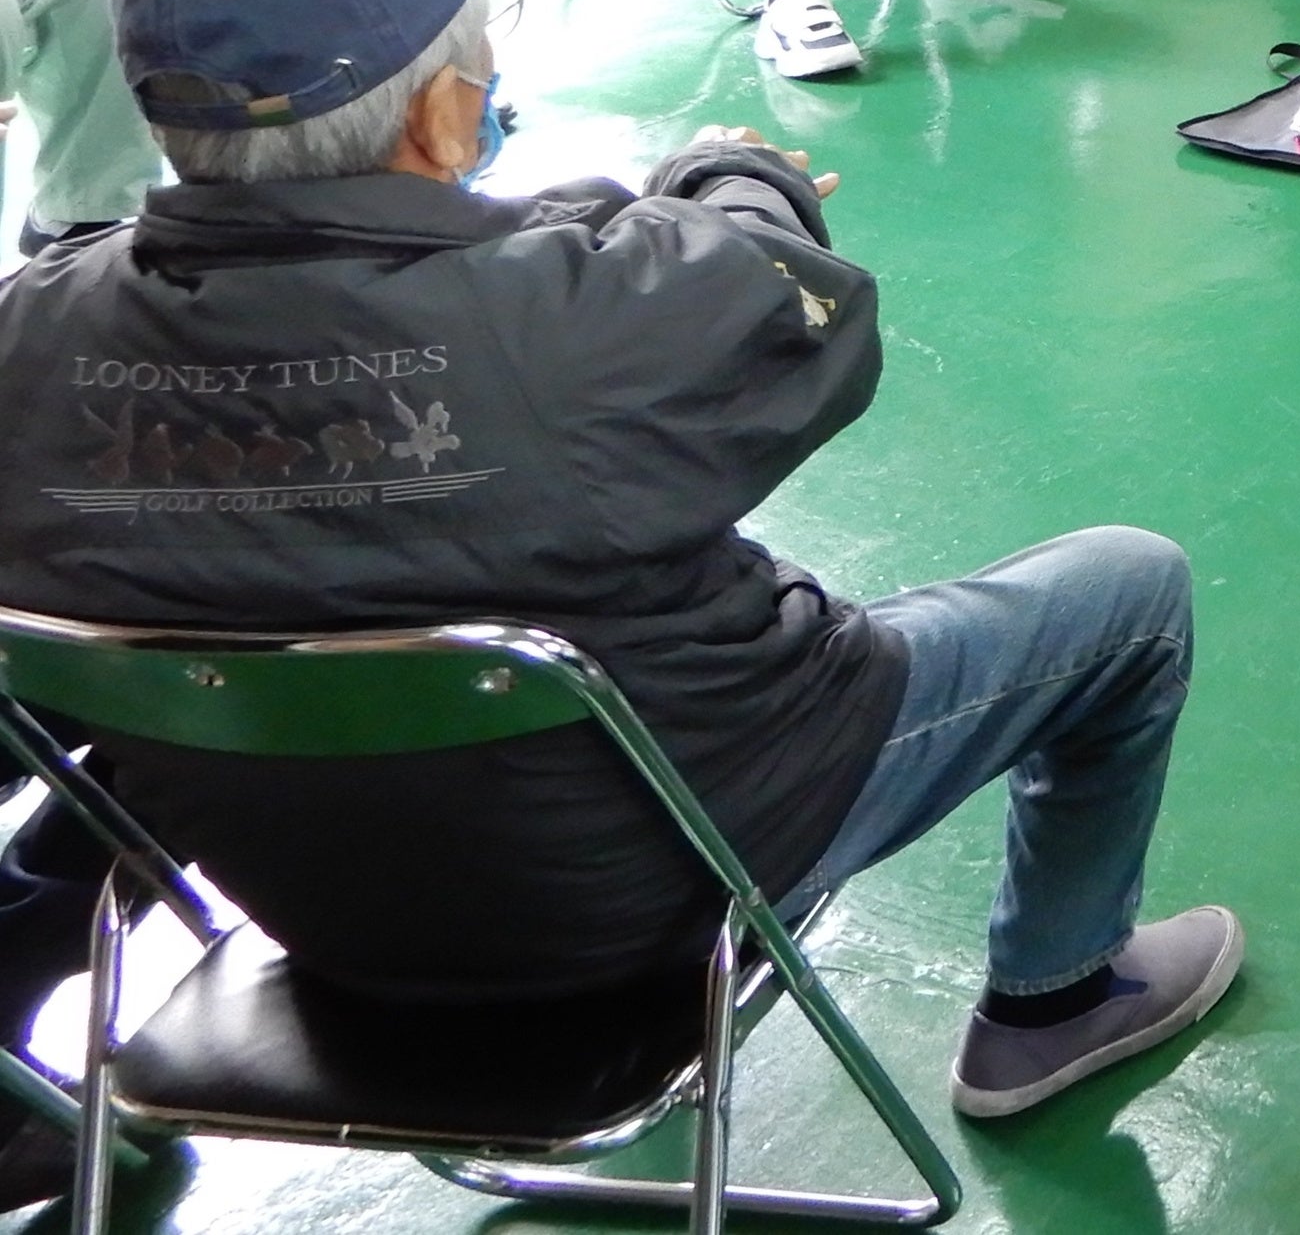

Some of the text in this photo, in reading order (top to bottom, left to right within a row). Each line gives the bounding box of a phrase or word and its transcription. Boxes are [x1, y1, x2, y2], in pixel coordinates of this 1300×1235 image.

[73, 345, 448, 394] LOONEY TUNES
[145, 486, 374, 514] GOLF COLLECTION
